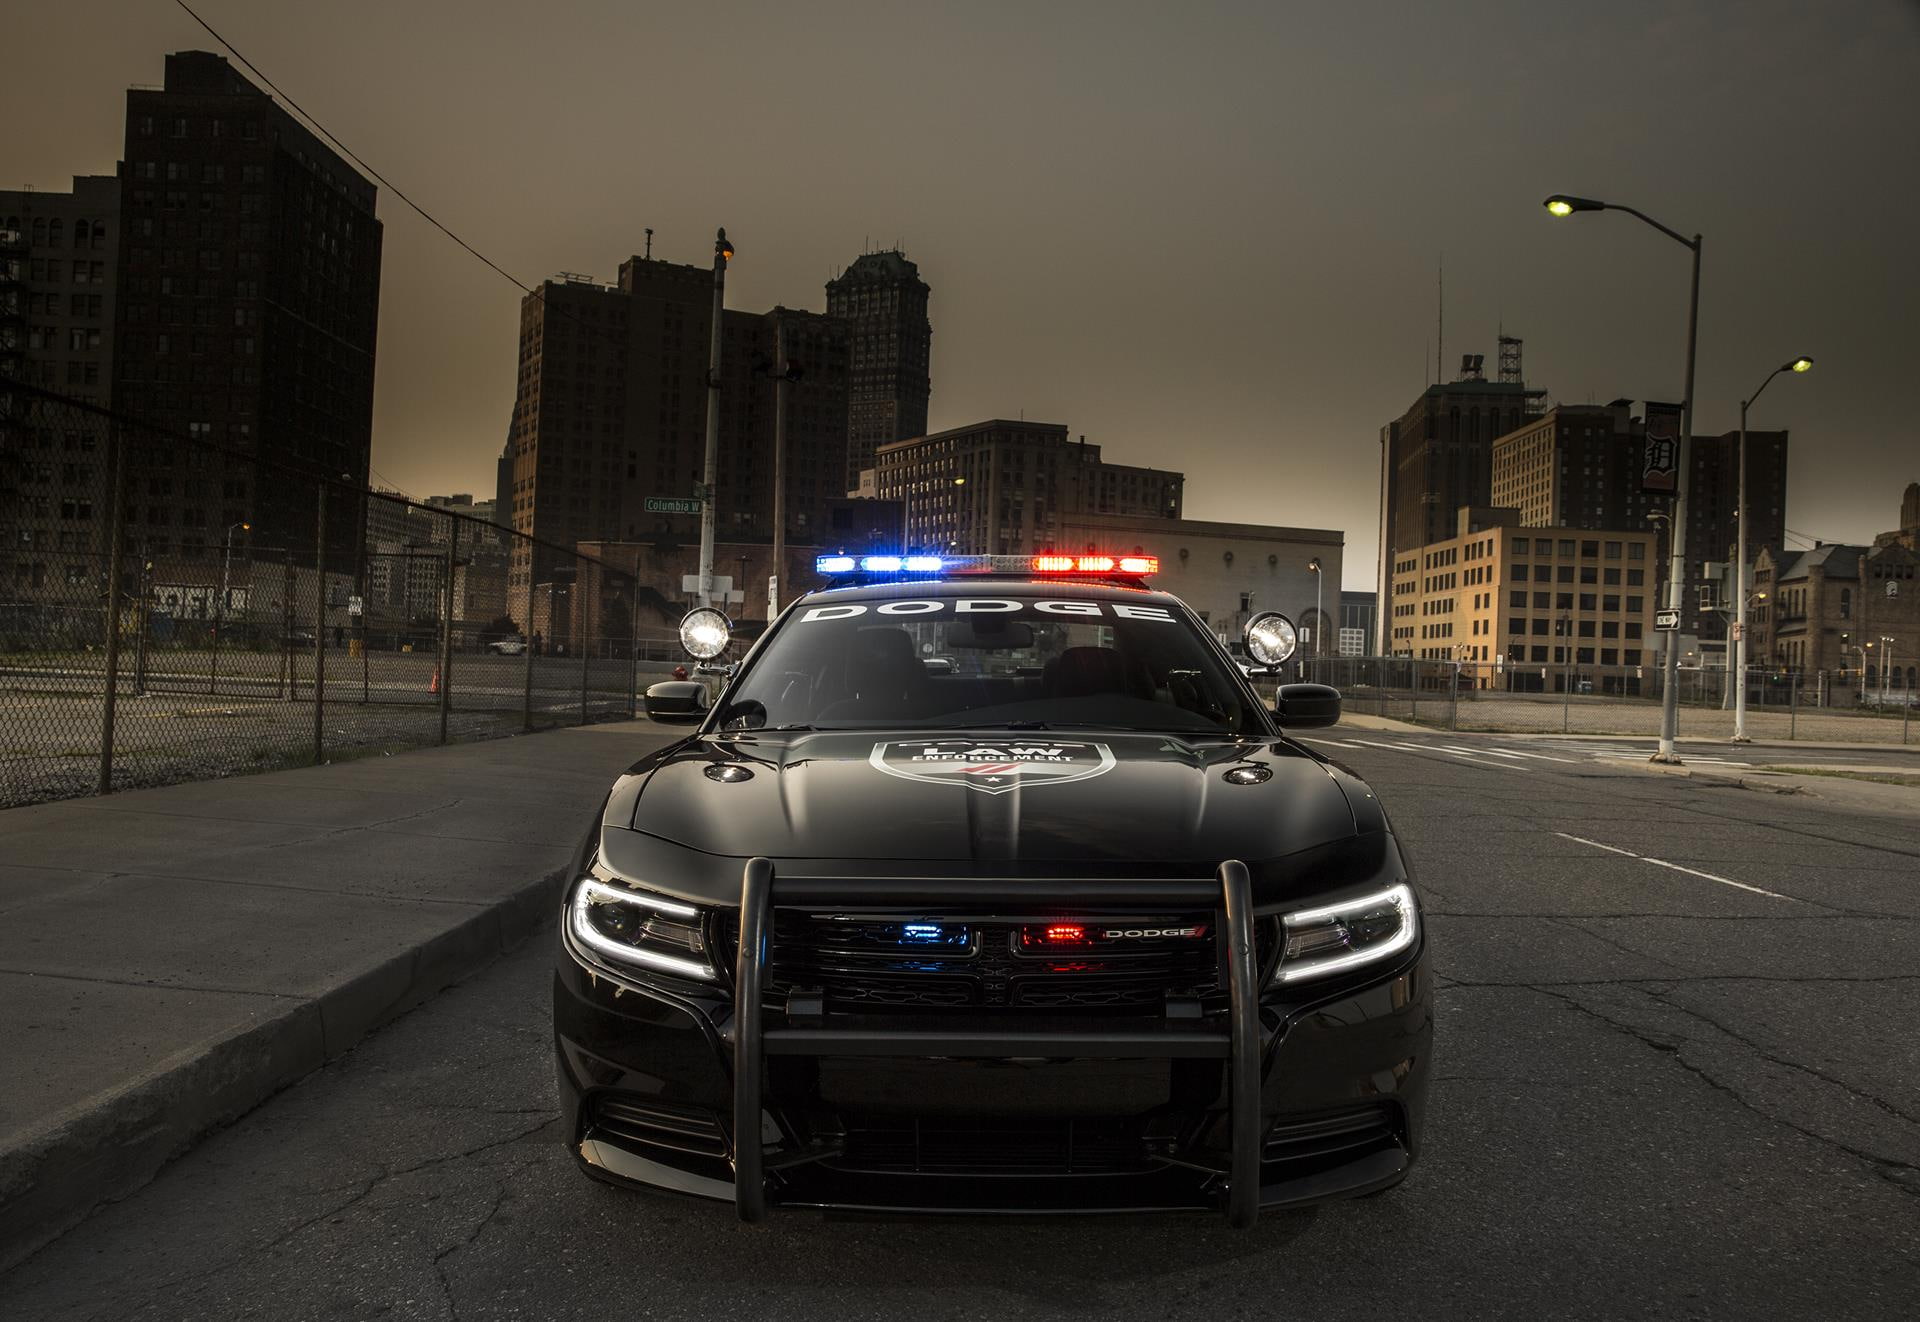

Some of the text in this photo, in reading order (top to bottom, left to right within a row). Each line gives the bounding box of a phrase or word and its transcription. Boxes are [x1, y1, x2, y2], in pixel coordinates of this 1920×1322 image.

[647, 499, 700, 512] Columbia W
[800, 599, 1176, 622] DODGE
[923, 747, 1064, 756] LAW
[911, 753, 1074, 762] ENFORCEMENT
[1105, 928, 1196, 938] DODGE
